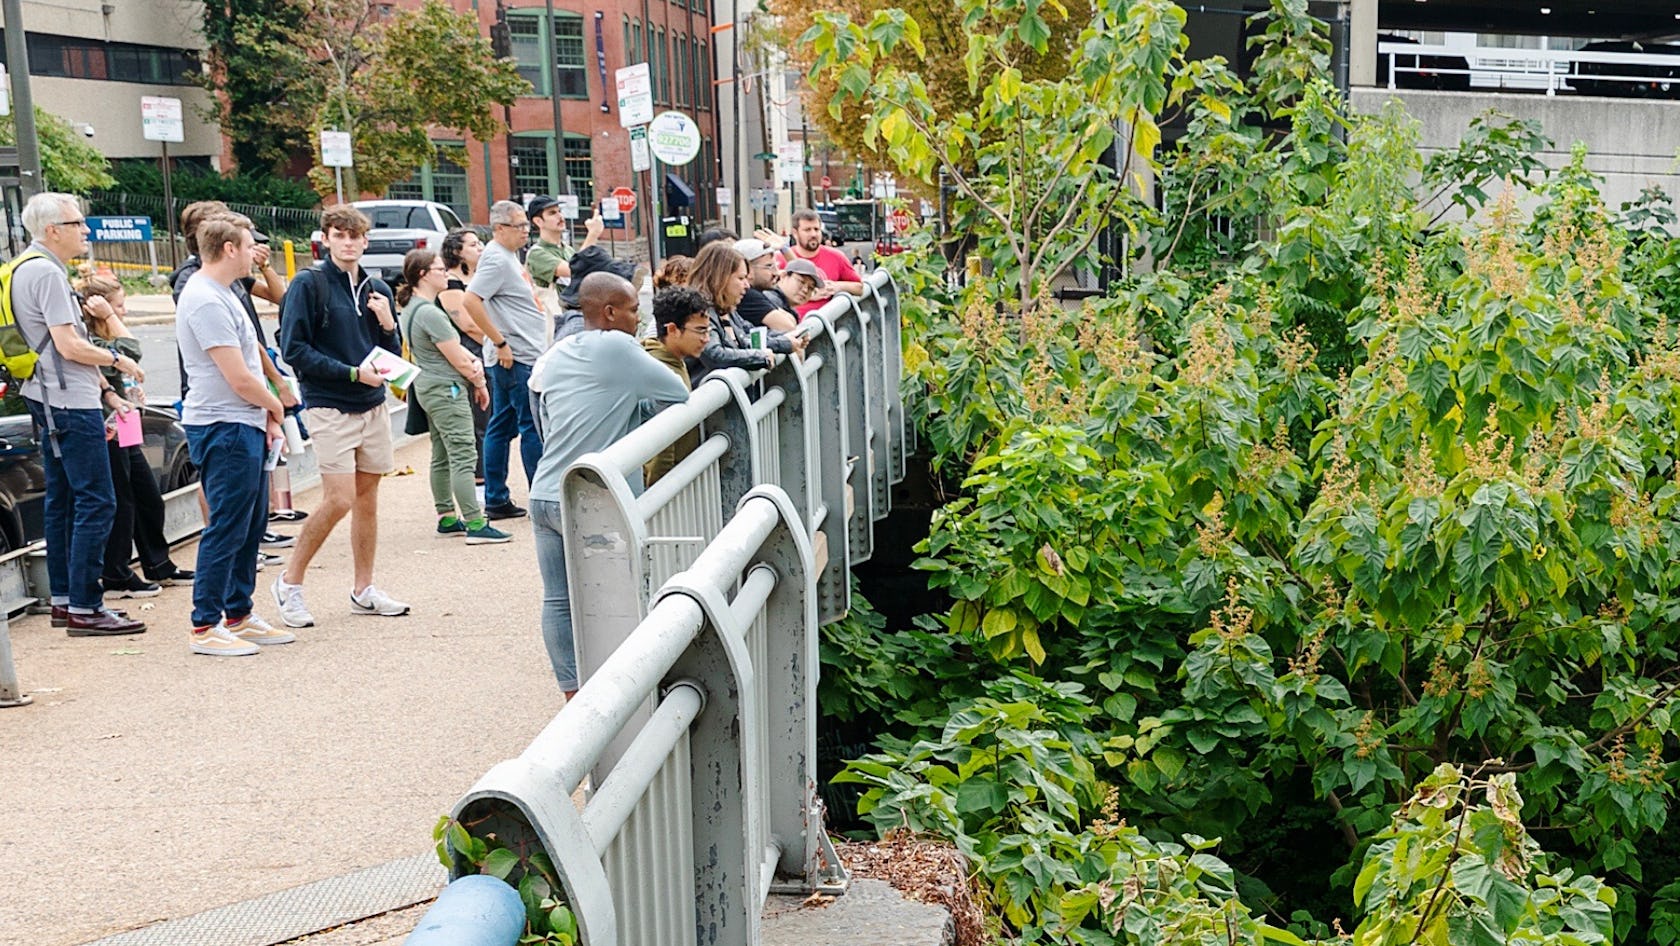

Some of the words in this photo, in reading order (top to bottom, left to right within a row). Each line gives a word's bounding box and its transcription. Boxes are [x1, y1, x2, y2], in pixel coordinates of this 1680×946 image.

[614, 194, 636, 206] TOP
[102, 219, 133, 229] PUBLIC
[95, 229, 143, 240] PARKING
